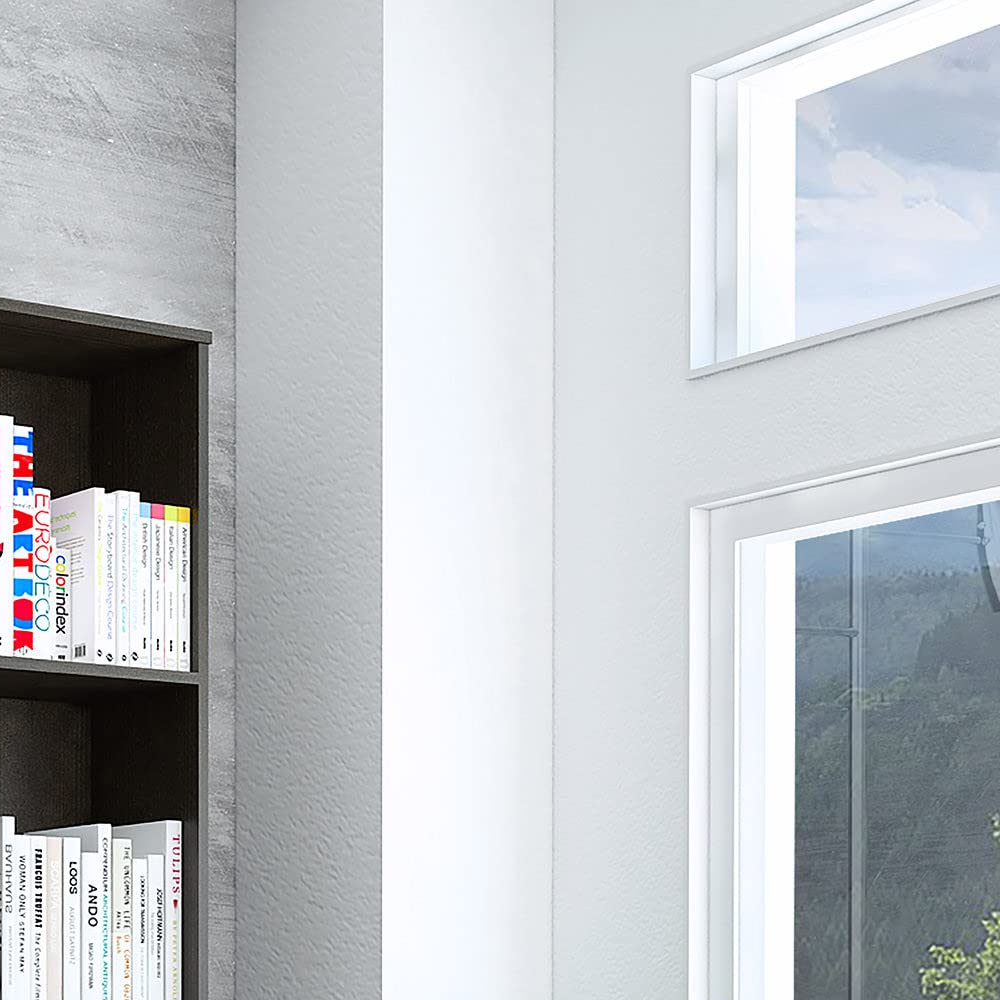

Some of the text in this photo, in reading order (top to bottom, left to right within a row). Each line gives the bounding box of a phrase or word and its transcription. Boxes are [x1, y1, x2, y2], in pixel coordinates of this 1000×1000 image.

[13, 431, 33, 496] THE
[13, 509, 33, 573] ART
[56, 555, 69, 634] colorindex
[69, 861, 77, 895] LOOS
[172, 834, 180, 894] TULIPS
[88, 884, 98, 927] ANDO
